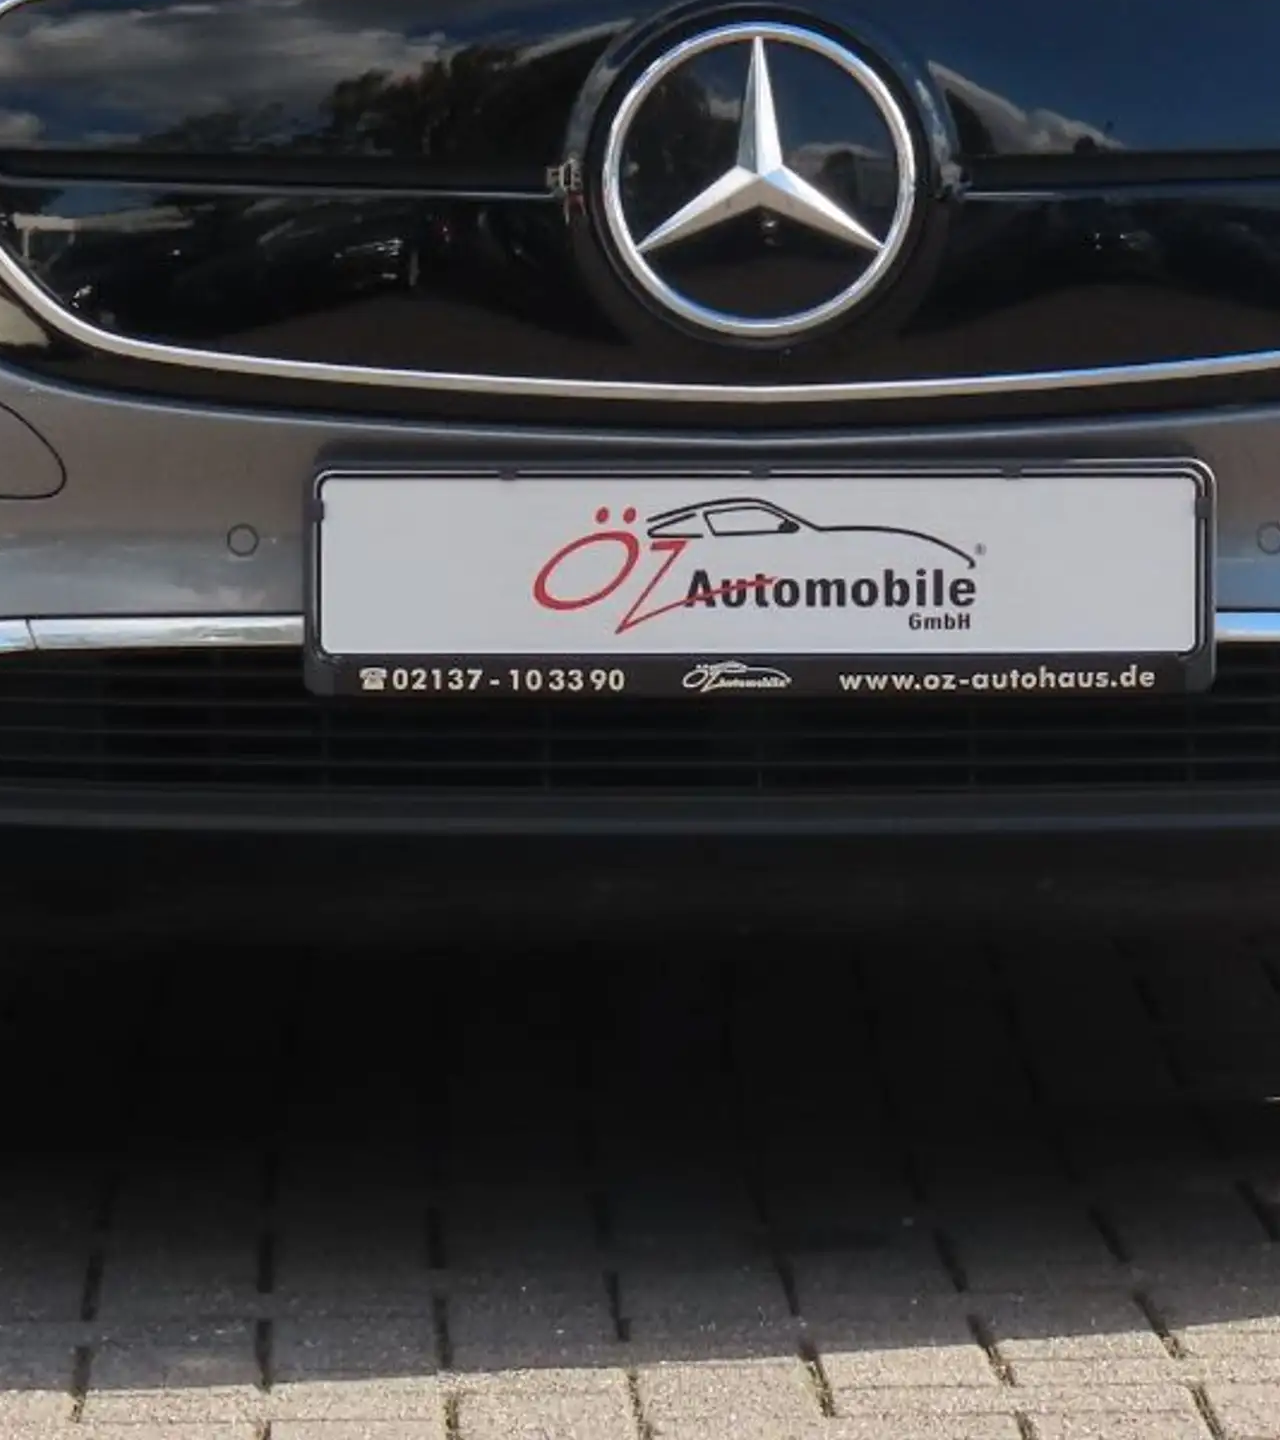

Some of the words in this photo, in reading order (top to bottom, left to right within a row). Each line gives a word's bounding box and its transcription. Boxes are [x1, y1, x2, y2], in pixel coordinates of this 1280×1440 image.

[685, 569, 976, 608] Automobile
[908, 613, 970, 630] GmbH
[840, 665, 1154, 690] www.oz-autohaus.de
